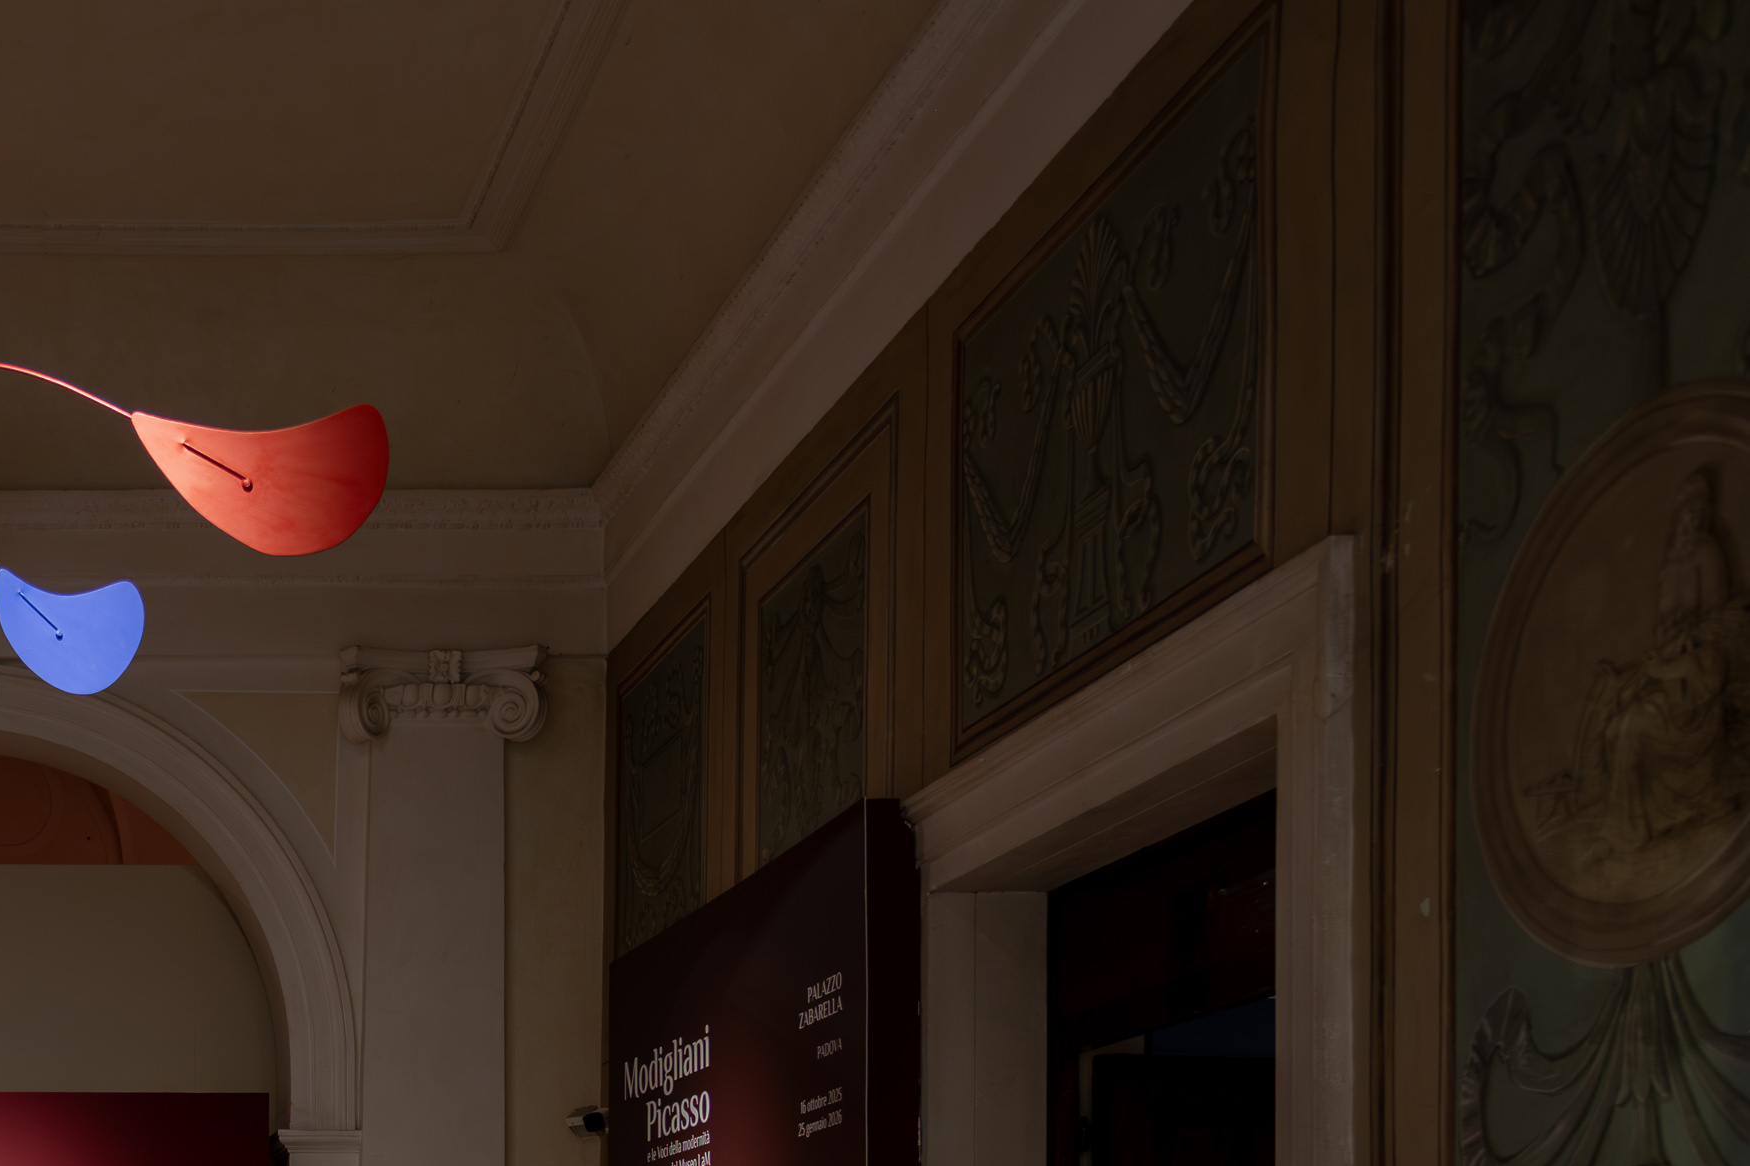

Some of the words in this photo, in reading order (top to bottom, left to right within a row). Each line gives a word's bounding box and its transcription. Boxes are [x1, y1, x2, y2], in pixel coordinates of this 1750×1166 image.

[807, 972, 842, 1003] PALAZZO
[798, 995, 842, 1030] ZABARELLA
[624, 1024, 709, 1100] Modigliani
[817, 1037, 842, 1059] PADOVA
[646, 1090, 710, 1142] Picasso
[801, 1100, 806, 1114] 16
[807, 1096, 826, 1113] ottobre
[828, 1087, 842, 1105] 2025
[798, 1122, 805, 1137] 25
[806, 1116, 826, 1137] gennaio
[828, 1110, 842, 1128] 2026
[647, 1153, 650, 1162] e
[651, 1148, 656, 1161] le
[657, 1145, 668, 1159] Voci
[669, 1140, 681, 1157] della
[682, 1130, 710, 1153] modernità
